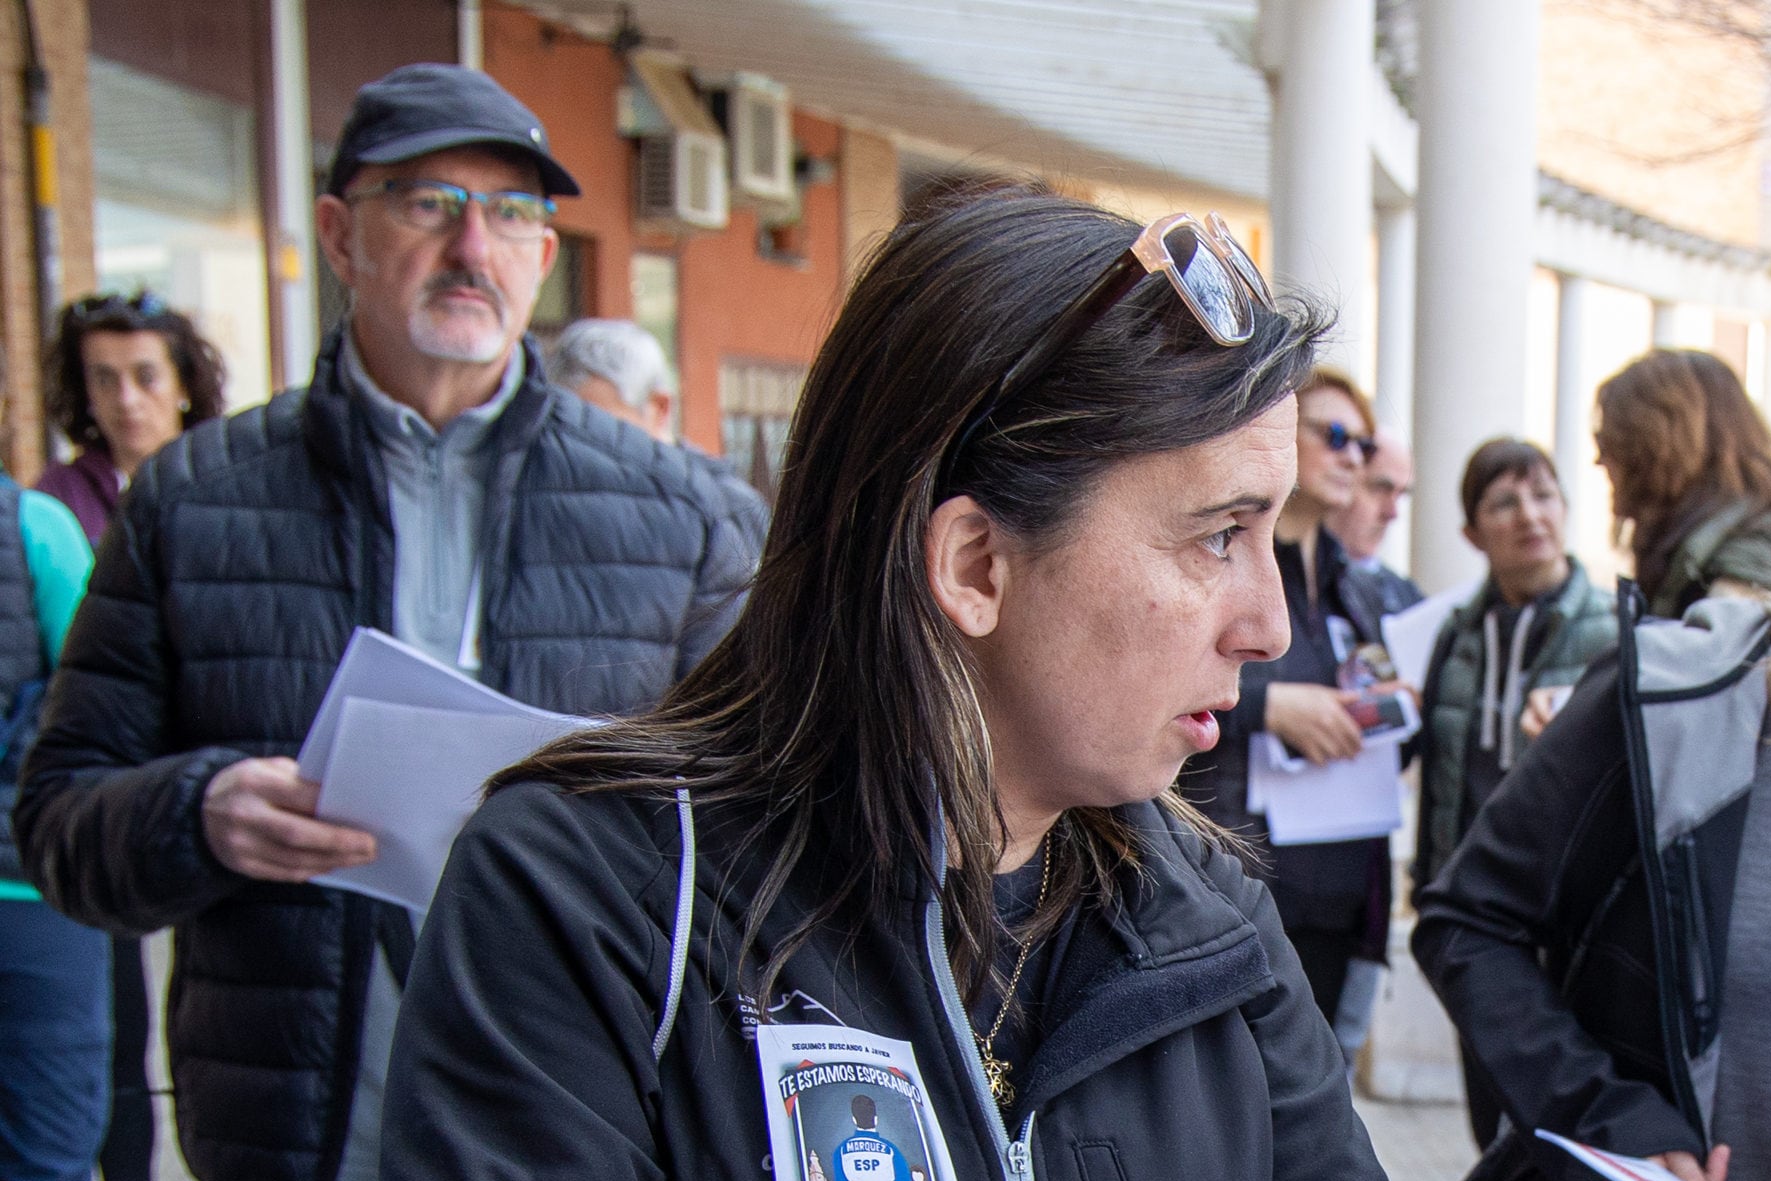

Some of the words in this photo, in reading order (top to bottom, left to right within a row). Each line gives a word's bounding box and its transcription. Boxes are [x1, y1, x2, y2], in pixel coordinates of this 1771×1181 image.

[829, 1043, 863, 1052] BUSCANDO
[779, 1074, 796, 1099] TE
[797, 1064, 857, 1091] ESTAMOS
[856, 1065, 921, 1104] ESPERANDO
[846, 1141, 887, 1152] MARQUEZ
[854, 1159, 880, 1171] ESP
